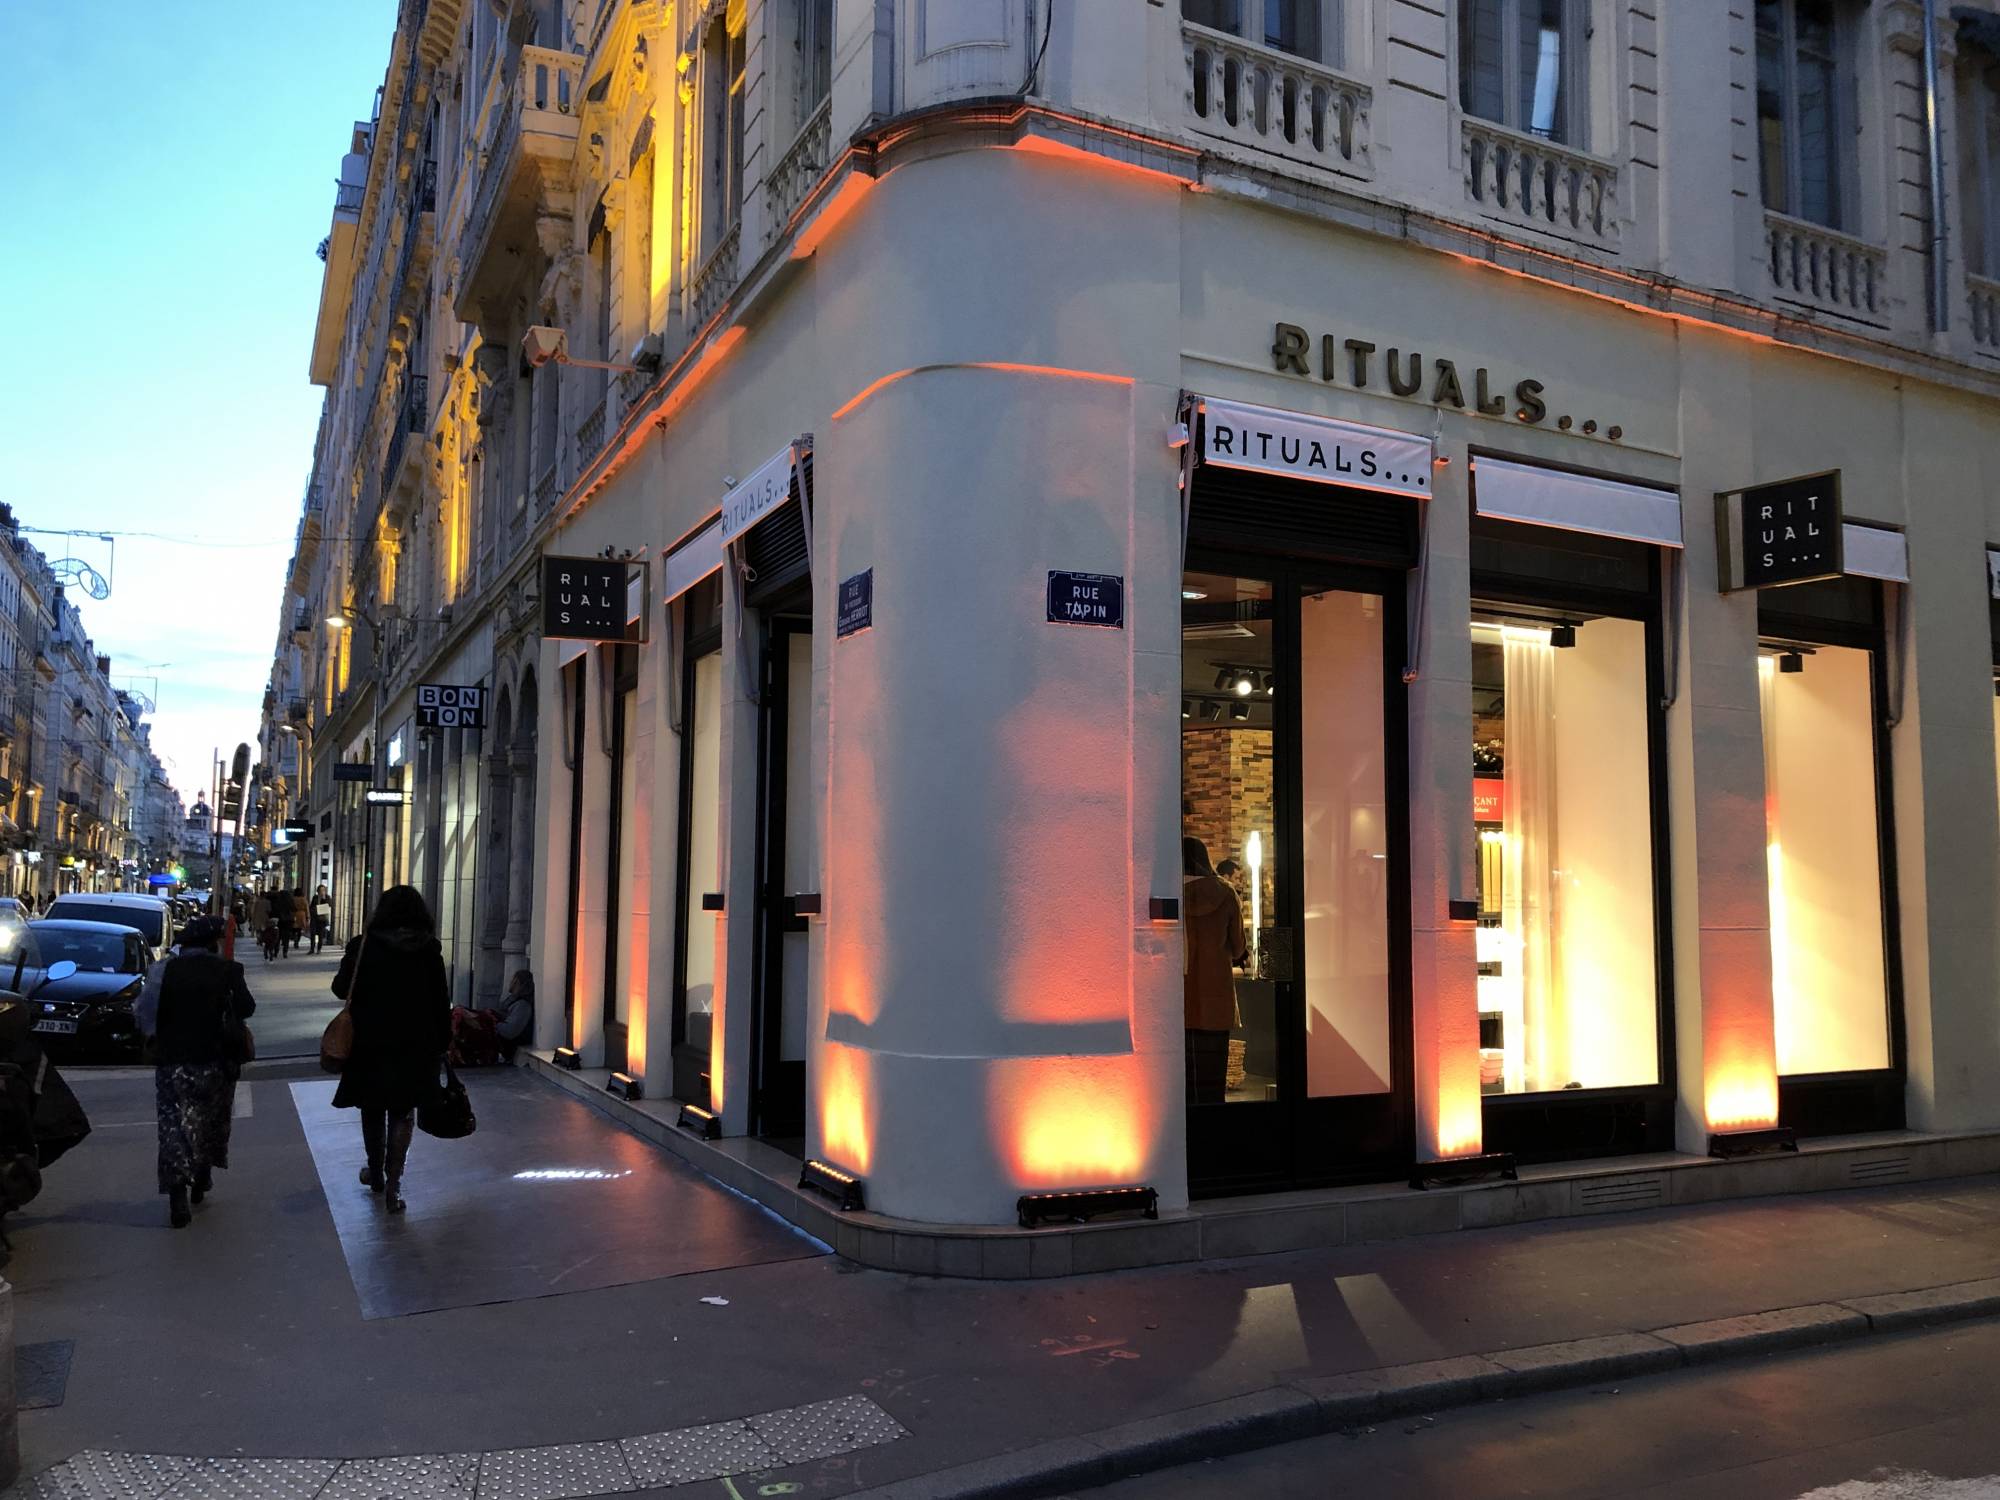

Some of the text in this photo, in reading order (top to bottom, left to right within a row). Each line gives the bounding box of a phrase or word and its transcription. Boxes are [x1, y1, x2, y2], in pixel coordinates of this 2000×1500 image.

[1272, 322, 1623, 440] RITUALS...
[1213, 425, 1425, 486] RITUALS...
[1073, 585, 1099, 600] RUE
[423, 688, 476, 706] BON
[423, 708, 475, 725] TON
